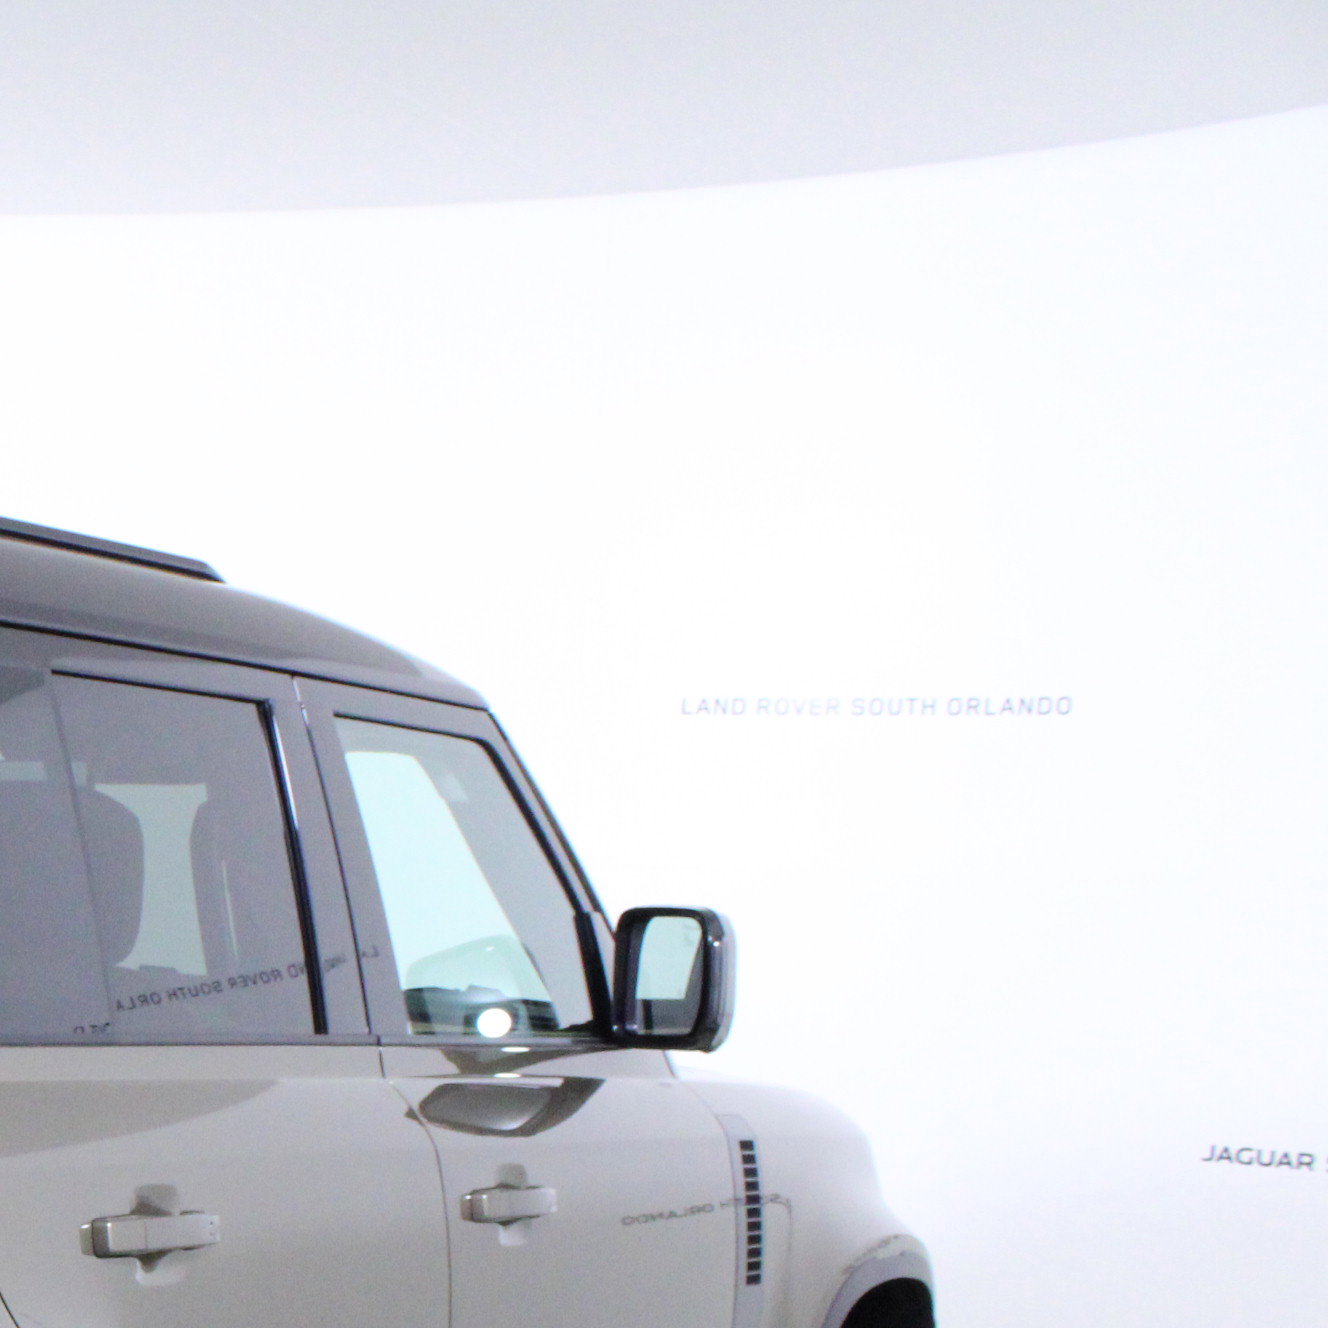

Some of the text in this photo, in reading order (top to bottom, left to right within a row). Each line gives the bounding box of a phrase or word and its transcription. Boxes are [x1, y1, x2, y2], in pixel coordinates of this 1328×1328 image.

[680, 696, 1073, 716] LAND ROVER SOUTH ORLANDO
[1201, 1144, 1316, 1171] JAGUAR
